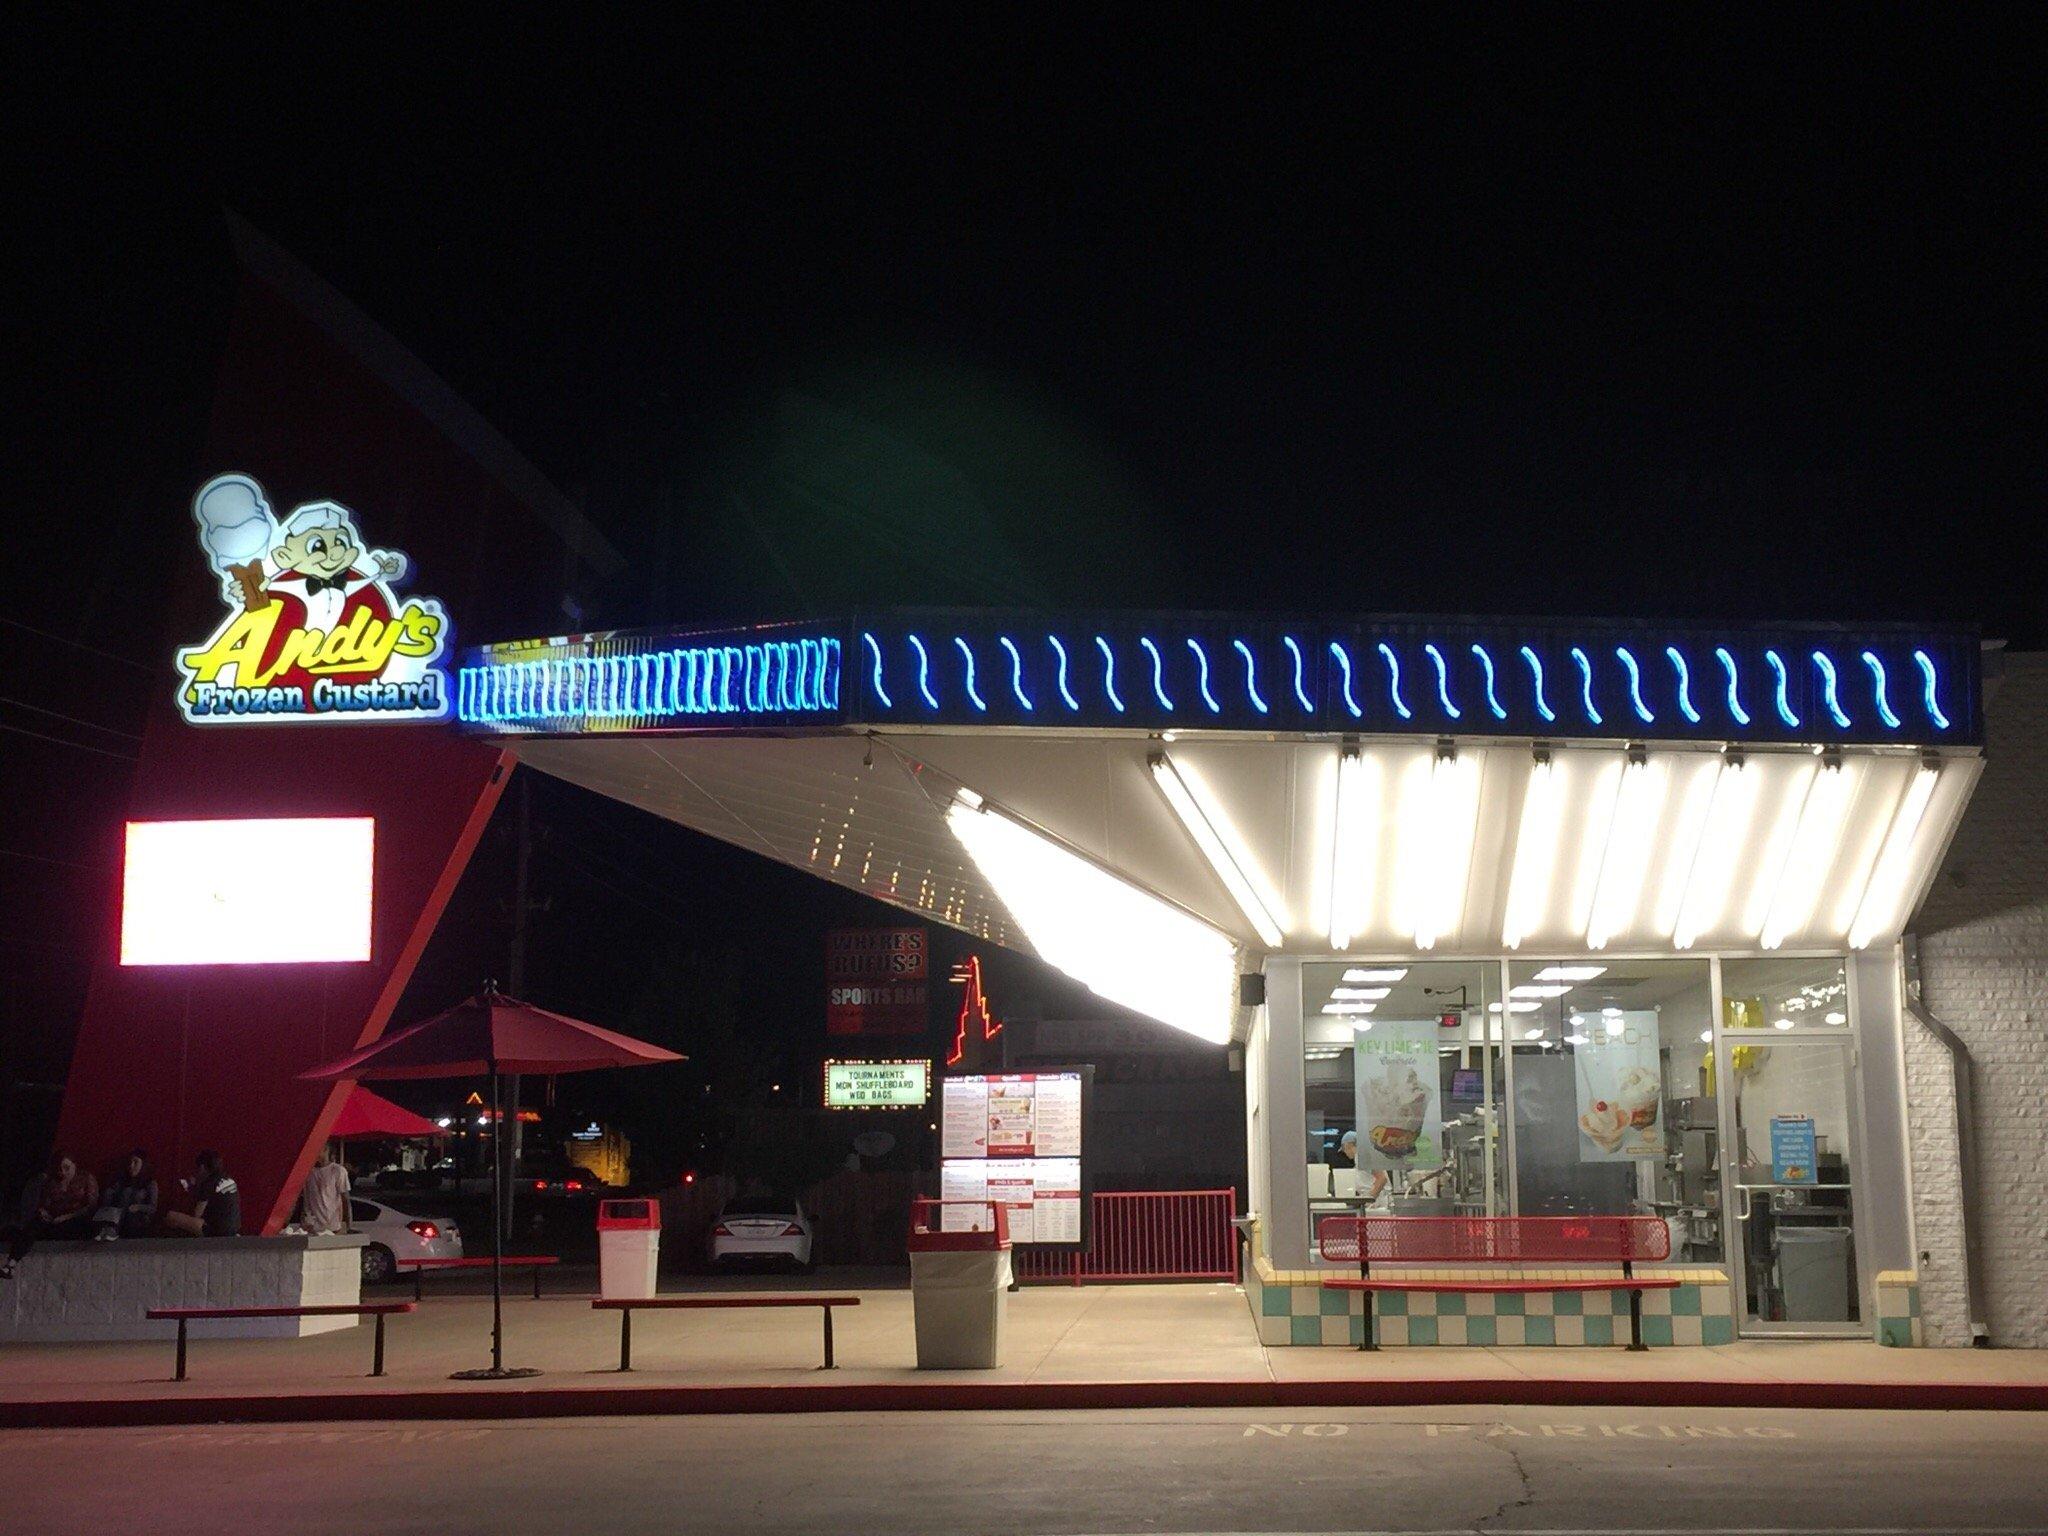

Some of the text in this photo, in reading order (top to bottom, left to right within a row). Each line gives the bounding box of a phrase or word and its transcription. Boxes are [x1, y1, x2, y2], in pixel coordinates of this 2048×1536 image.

[184, 599, 440, 688] Andy's
[191, 674, 440, 715] Frozen Custard
[831, 987, 892, 1005] SPORTS
[849, 1070, 905, 1080] TOURNAMENTS
[856, 1080, 914, 1090] SHUFFLEBOARD
[850, 1090, 893, 1100] WED BAGS
[1242, 1423, 1798, 1440] NO PARKING
